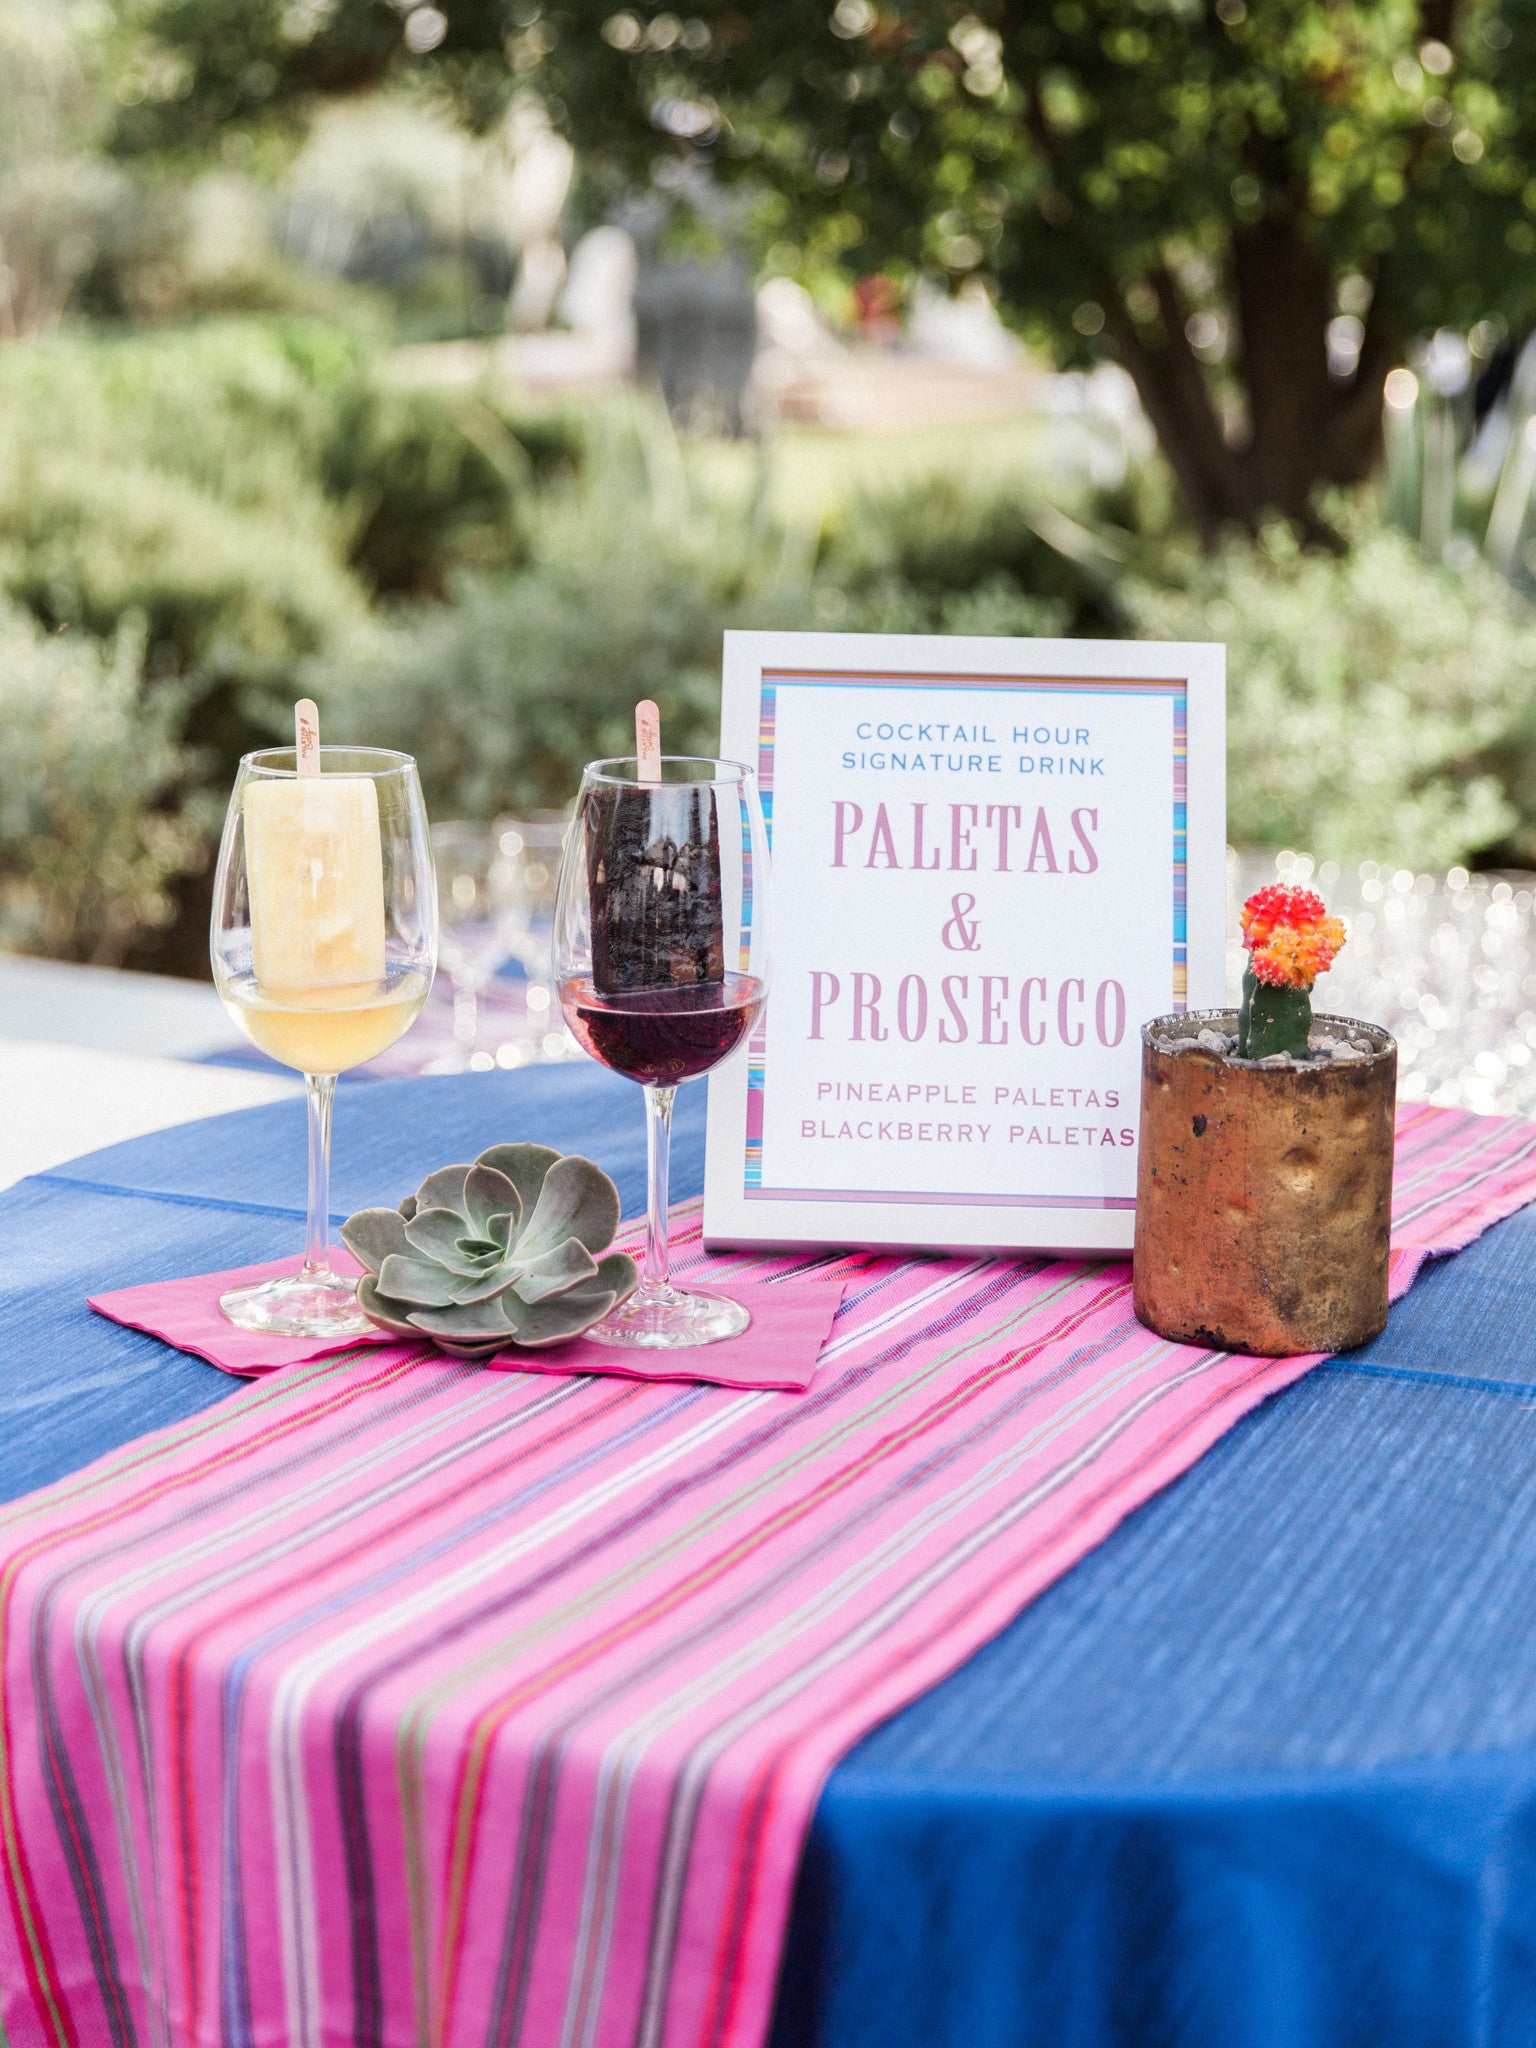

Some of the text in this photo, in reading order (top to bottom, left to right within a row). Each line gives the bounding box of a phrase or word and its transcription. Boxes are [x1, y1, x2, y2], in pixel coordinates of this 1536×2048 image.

[856, 722, 1090, 746] COCKTAIL HOUR
[841, 752, 1105, 776] SIGNATURE DRINK
[829, 800, 1099, 874] PALETAS
[941, 892, 982, 951] &
[806, 971, 1126, 1048] PROSECCO
[817, 1081, 1120, 1108] PINEAPPLE PALETAS
[801, 1119, 1136, 1147] BLACKBERRY PALETAS
